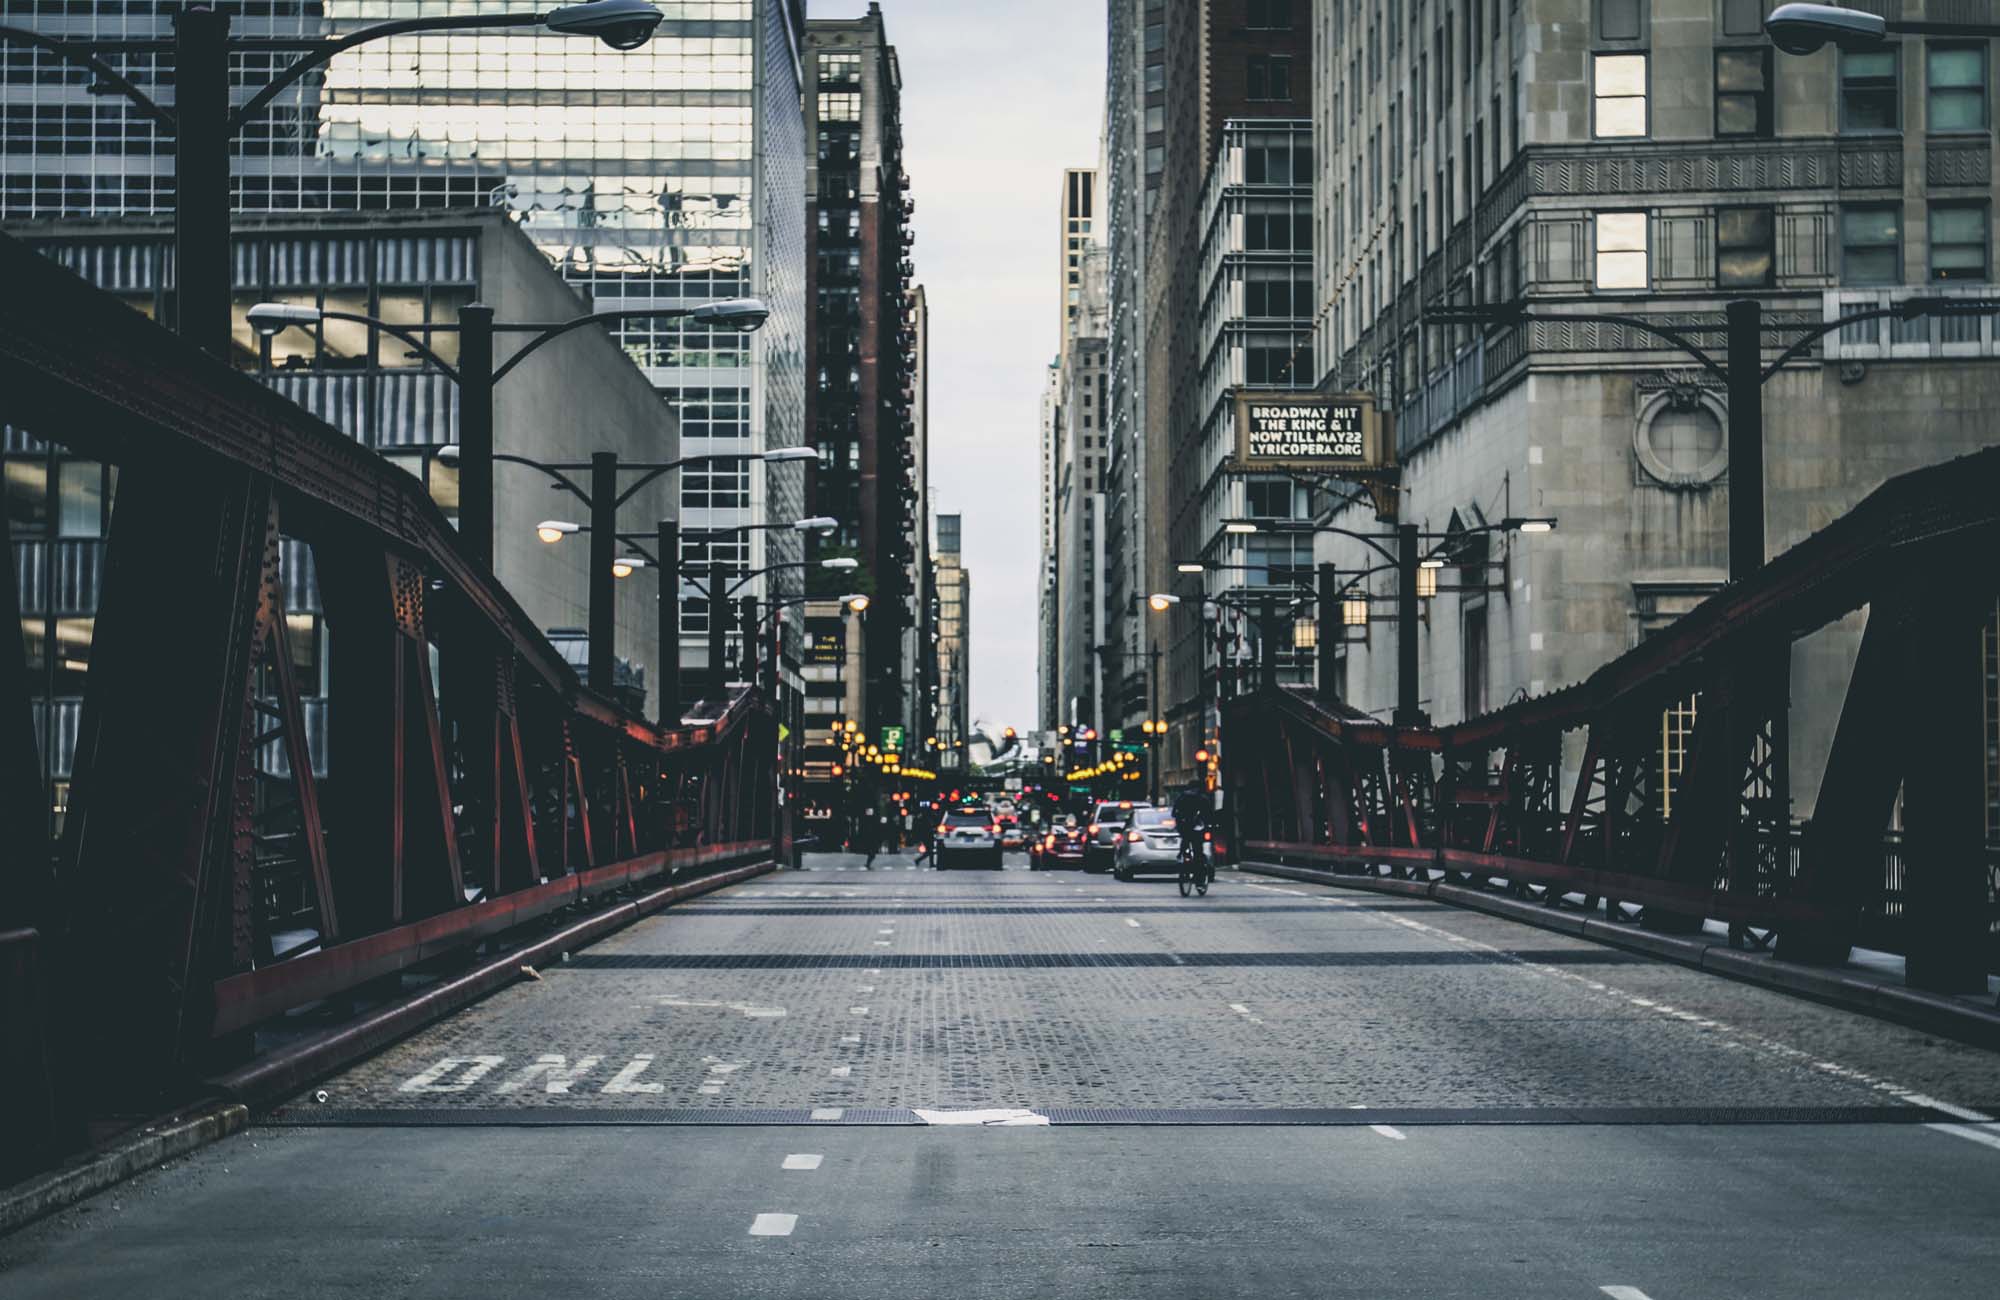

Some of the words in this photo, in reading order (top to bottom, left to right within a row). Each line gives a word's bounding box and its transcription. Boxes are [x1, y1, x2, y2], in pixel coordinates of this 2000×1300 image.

[1252, 407, 1328, 418] BROADWAY
[1334, 407, 1358, 418] HIT
[1259, 419, 1286, 431] THE
[1291, 419, 1326, 431] KING
[1330, 419, 1342, 431] &
[1346, 419, 1351, 431] I
[1250, 431, 1282, 443] NOW
[1284, 431, 1315, 443] TILL
[1250, 443, 1361, 455] LYRICOPERA.ORG
